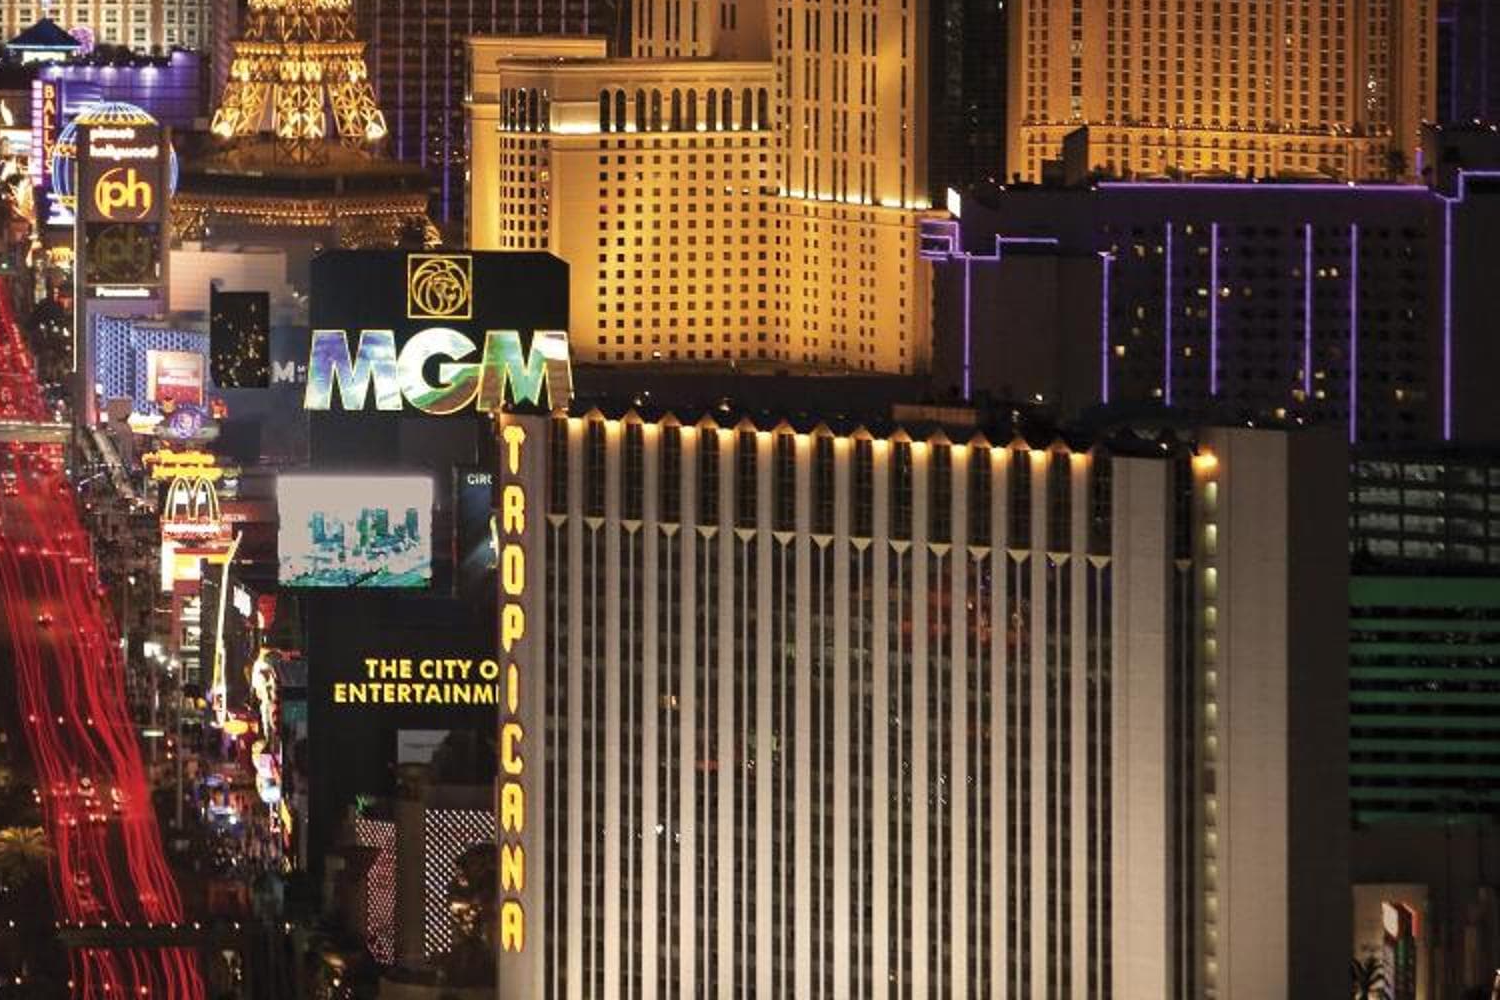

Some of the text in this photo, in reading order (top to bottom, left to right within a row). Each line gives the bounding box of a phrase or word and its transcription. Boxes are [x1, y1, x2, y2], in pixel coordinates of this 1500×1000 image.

[89, 143, 159, 161] hollywood
[100, 168, 152, 218] ph
[303, 327, 574, 416] MGM
[365, 658, 499, 680] THE CITY O
[334, 683, 499, 704] ENTERTAINM
[502, 425, 527, 953] TROPICANA
